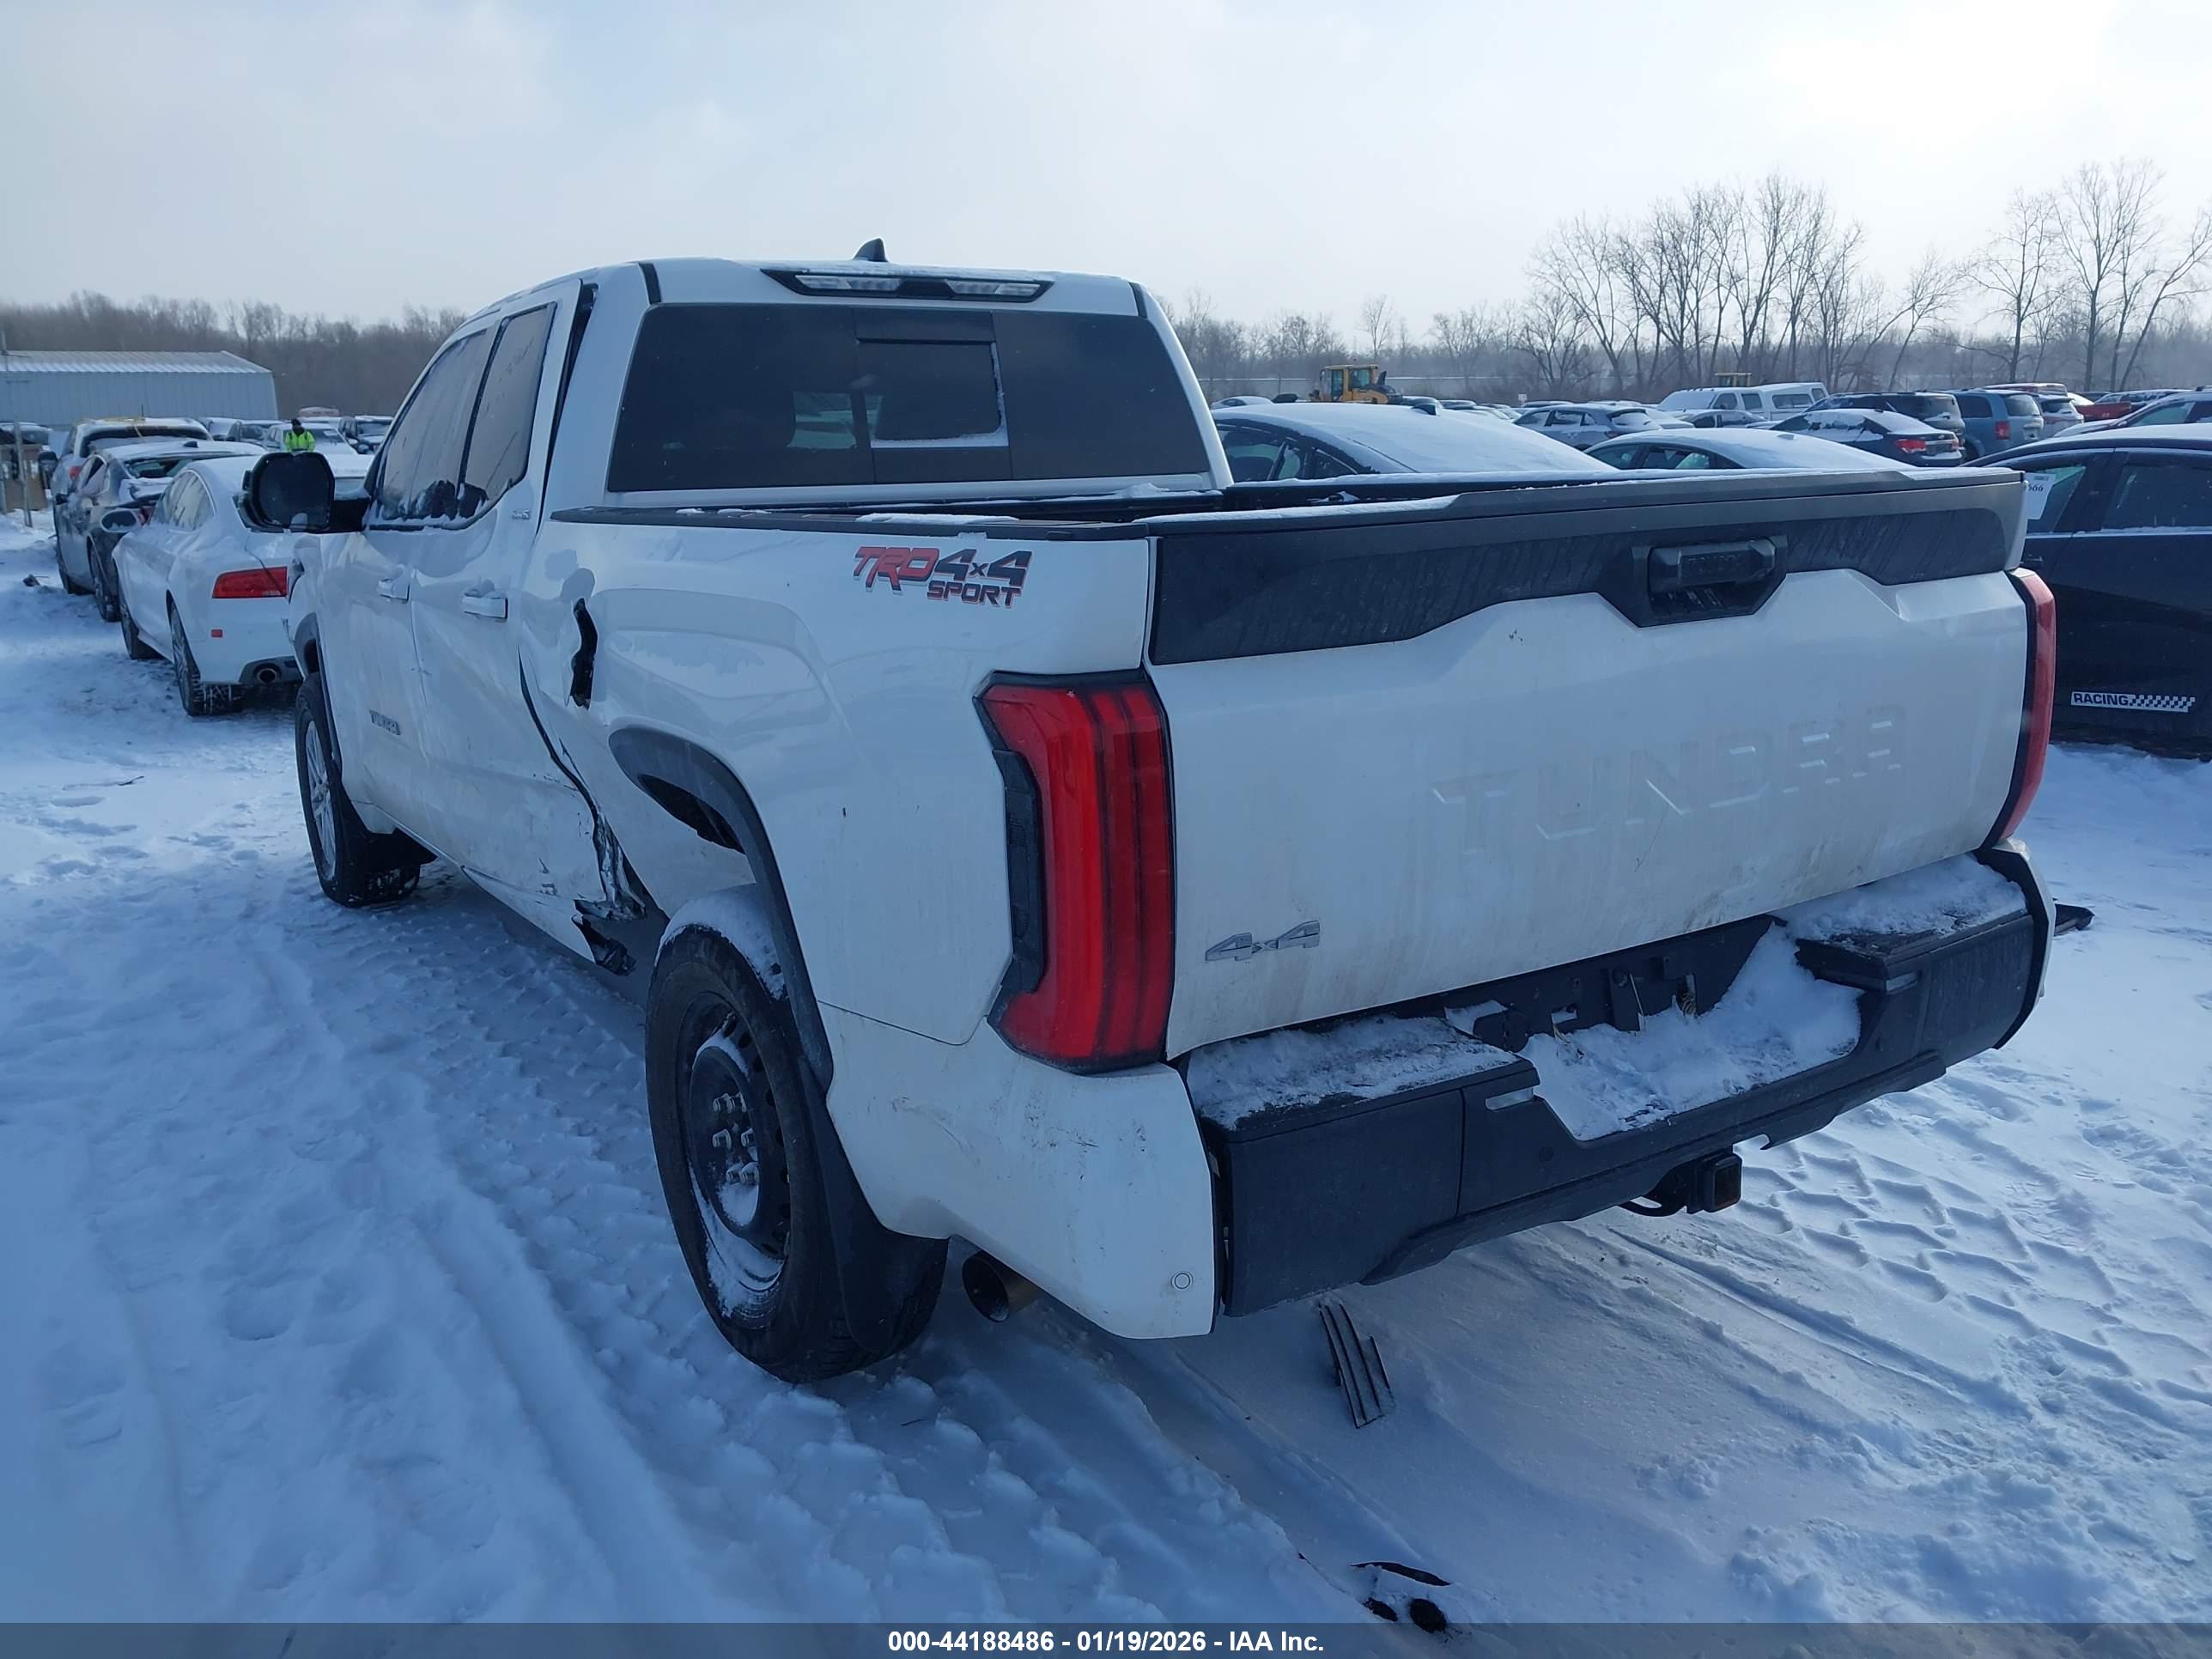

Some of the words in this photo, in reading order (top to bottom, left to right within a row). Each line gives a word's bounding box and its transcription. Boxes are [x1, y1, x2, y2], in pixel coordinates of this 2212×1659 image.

[853, 545, 940, 593] TRD
[934, 548, 1033, 587] 4x4
[927, 580, 1022, 609] SPORT
[2073, 692, 2129, 707] RACING
[1431, 703, 1906, 856] TUNDRA
[1204, 920, 1321, 962] 4x4
